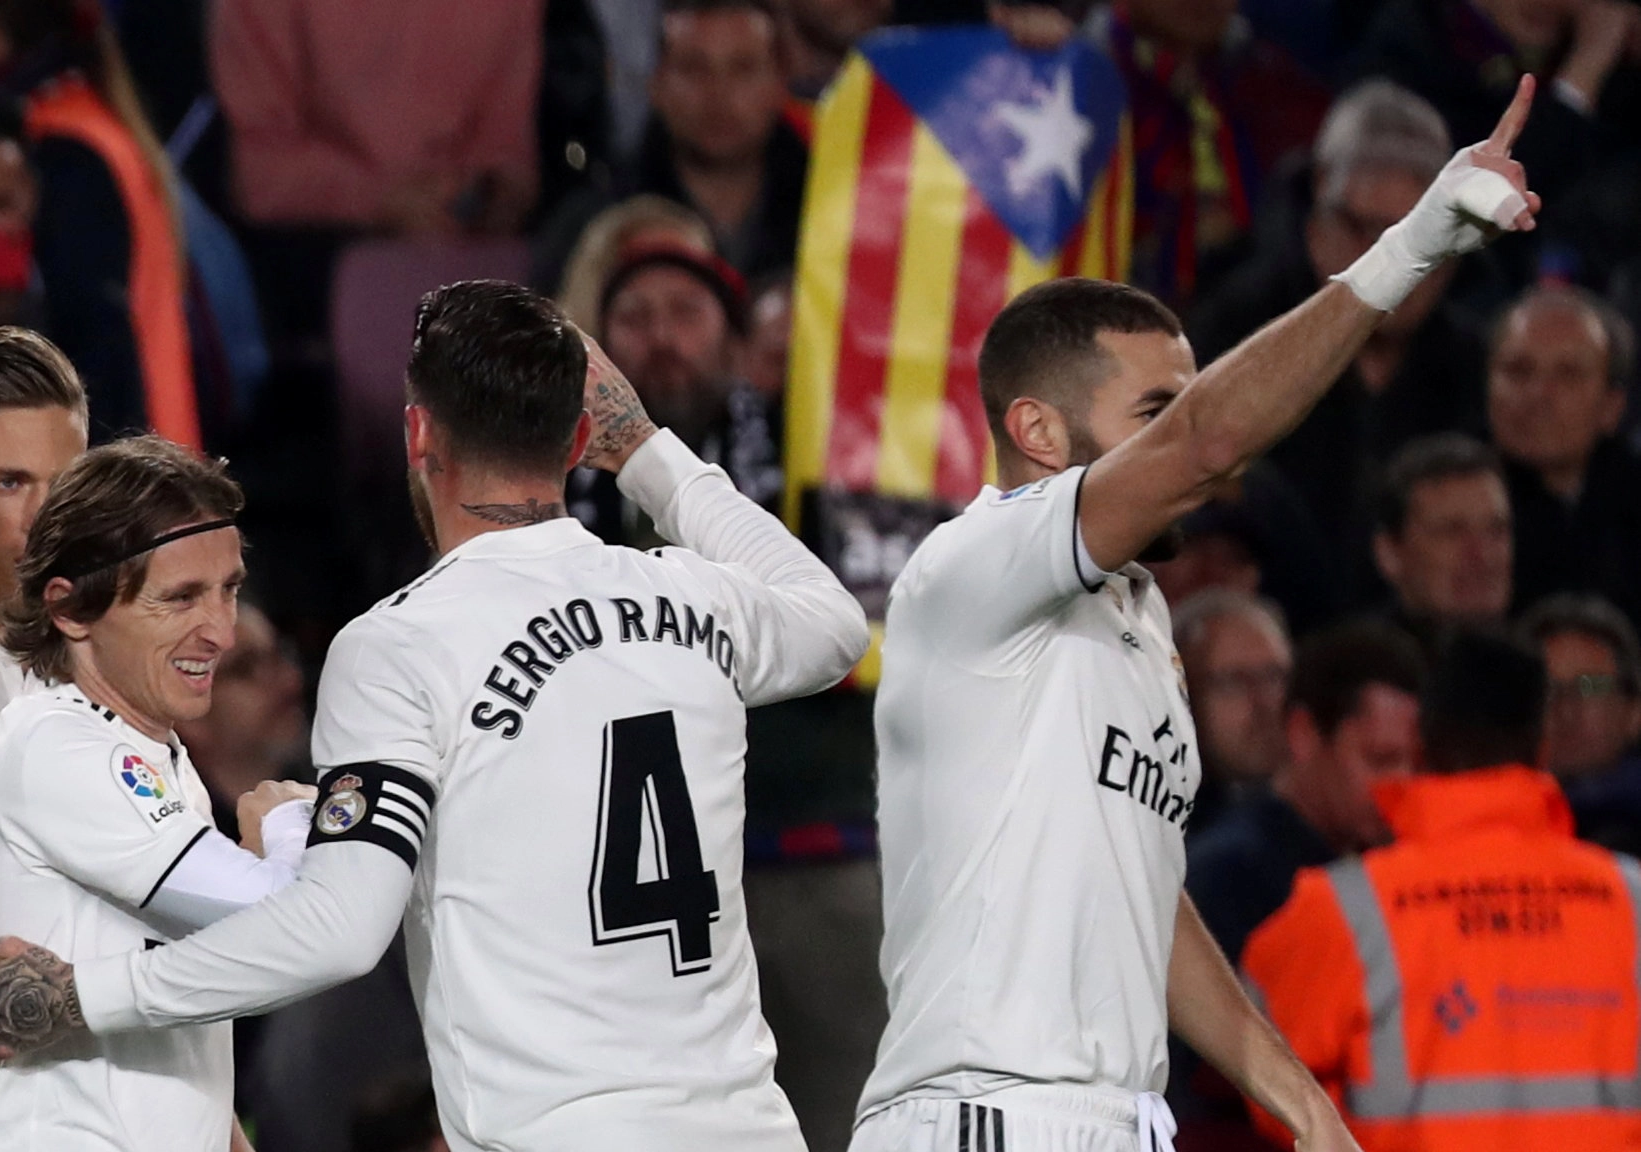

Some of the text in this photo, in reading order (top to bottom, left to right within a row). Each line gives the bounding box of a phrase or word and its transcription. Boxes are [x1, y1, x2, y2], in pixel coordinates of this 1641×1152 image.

[471, 595, 745, 740] SERGIO RAMO
[587, 709, 721, 977] 4
